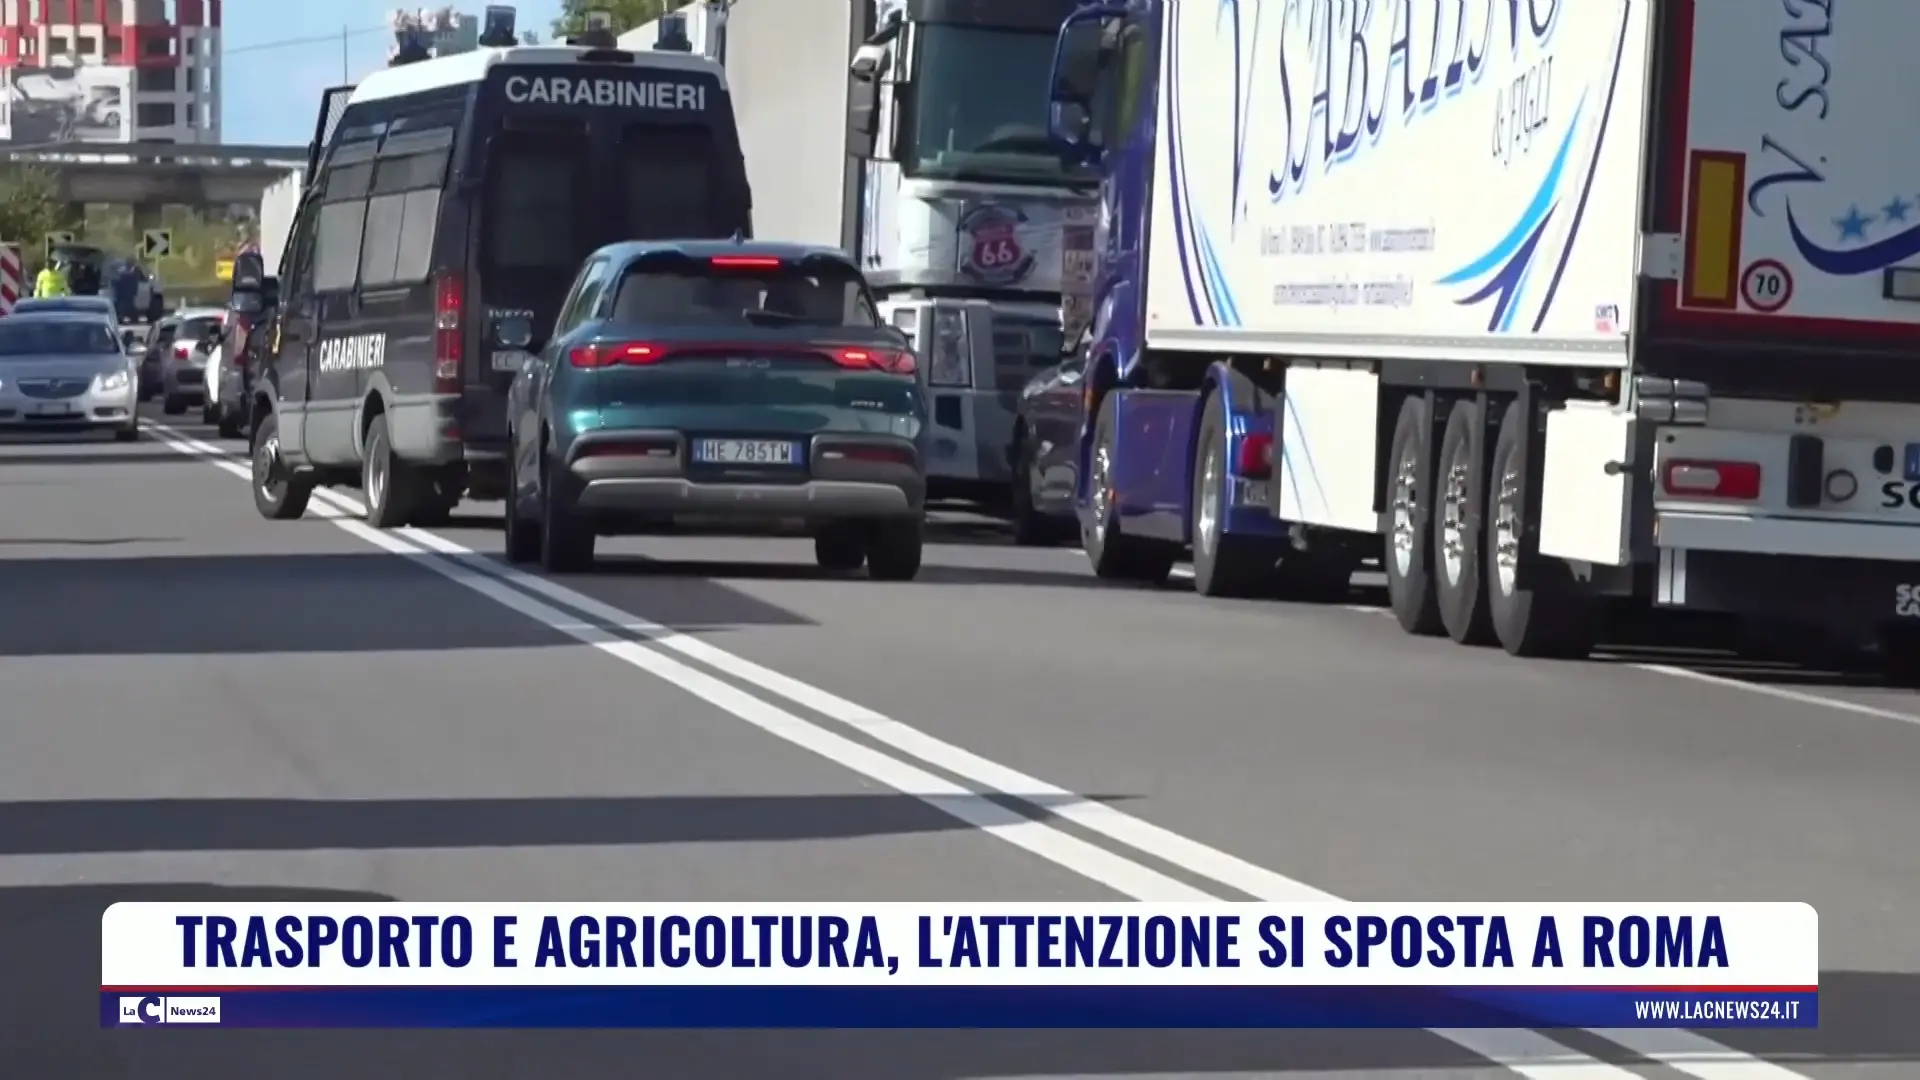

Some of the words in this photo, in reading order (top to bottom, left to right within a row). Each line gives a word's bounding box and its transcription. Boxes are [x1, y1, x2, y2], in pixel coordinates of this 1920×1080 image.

[505, 75, 705, 110] CARABINIERI
[982, 241, 1013, 266] 66
[1755, 274, 1780, 296] 70
[320, 332, 386, 373] CARABINIERI
